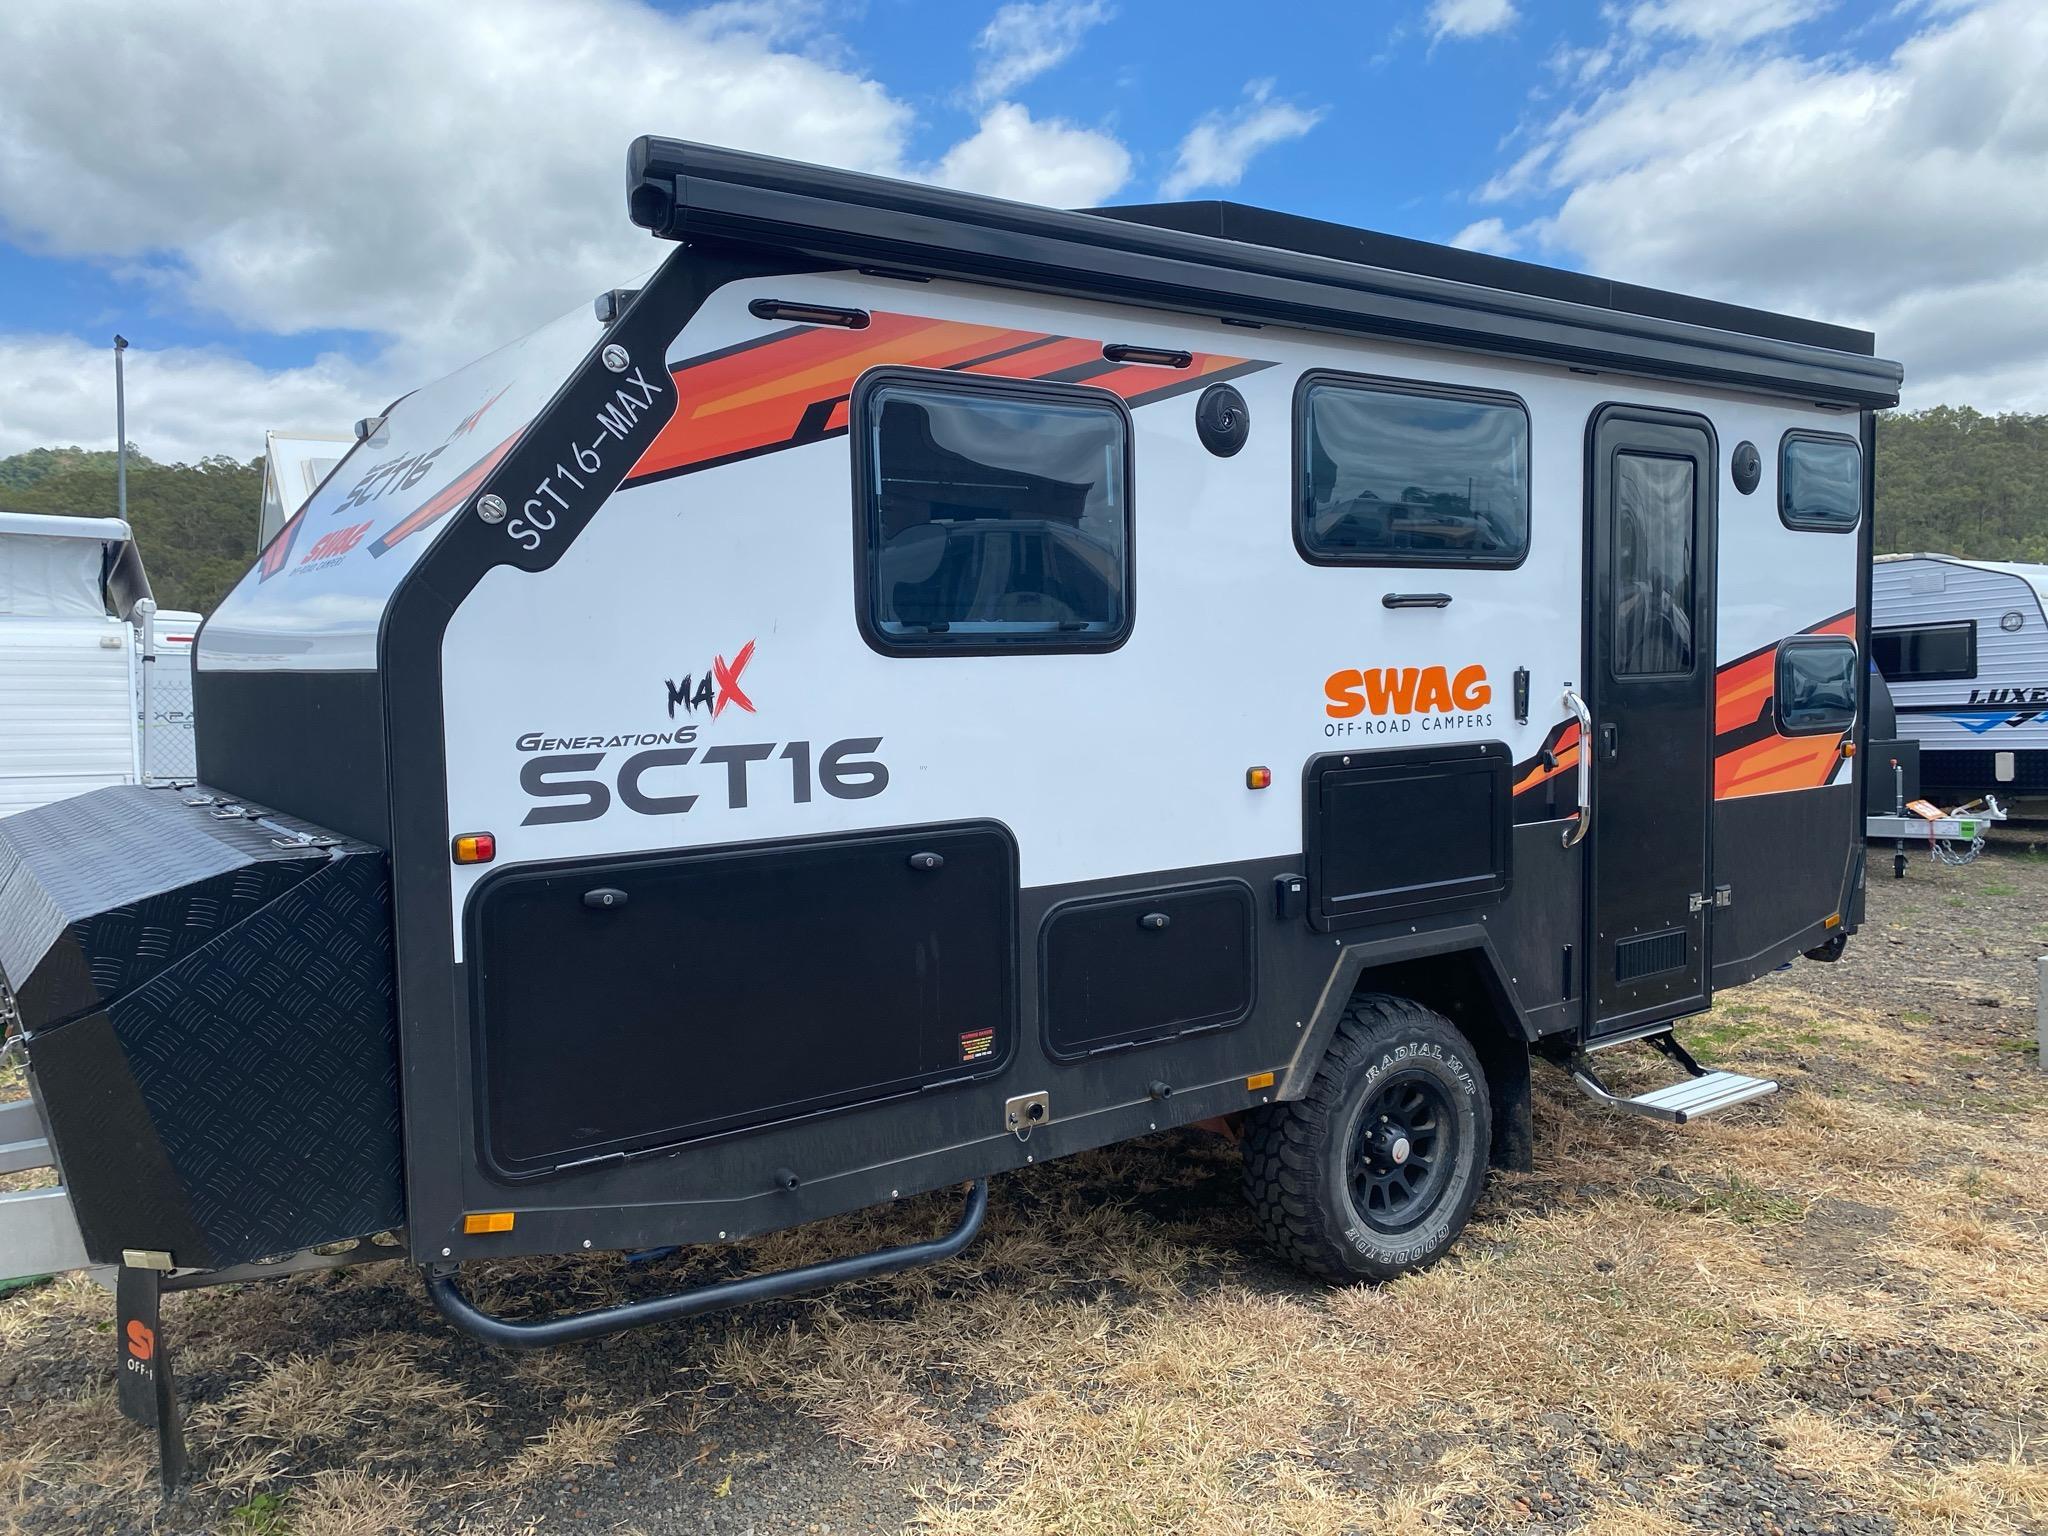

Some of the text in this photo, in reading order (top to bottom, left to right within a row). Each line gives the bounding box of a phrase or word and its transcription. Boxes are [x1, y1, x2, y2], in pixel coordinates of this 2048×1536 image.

[507, 367, 662, 550] SCT16-MAX
[664, 637, 757, 722] MAX
[1324, 664, 1492, 718] SWAG
[1324, 713, 1493, 738] OFF-ROAD CAMPERS
[520, 736, 889, 826] SCT16
[1366, 1043, 1476, 1095] RADIAL M/T
[1345, 1223, 1449, 1264] GOODRIDE
[127, 1359, 152, 1380] OFF-
